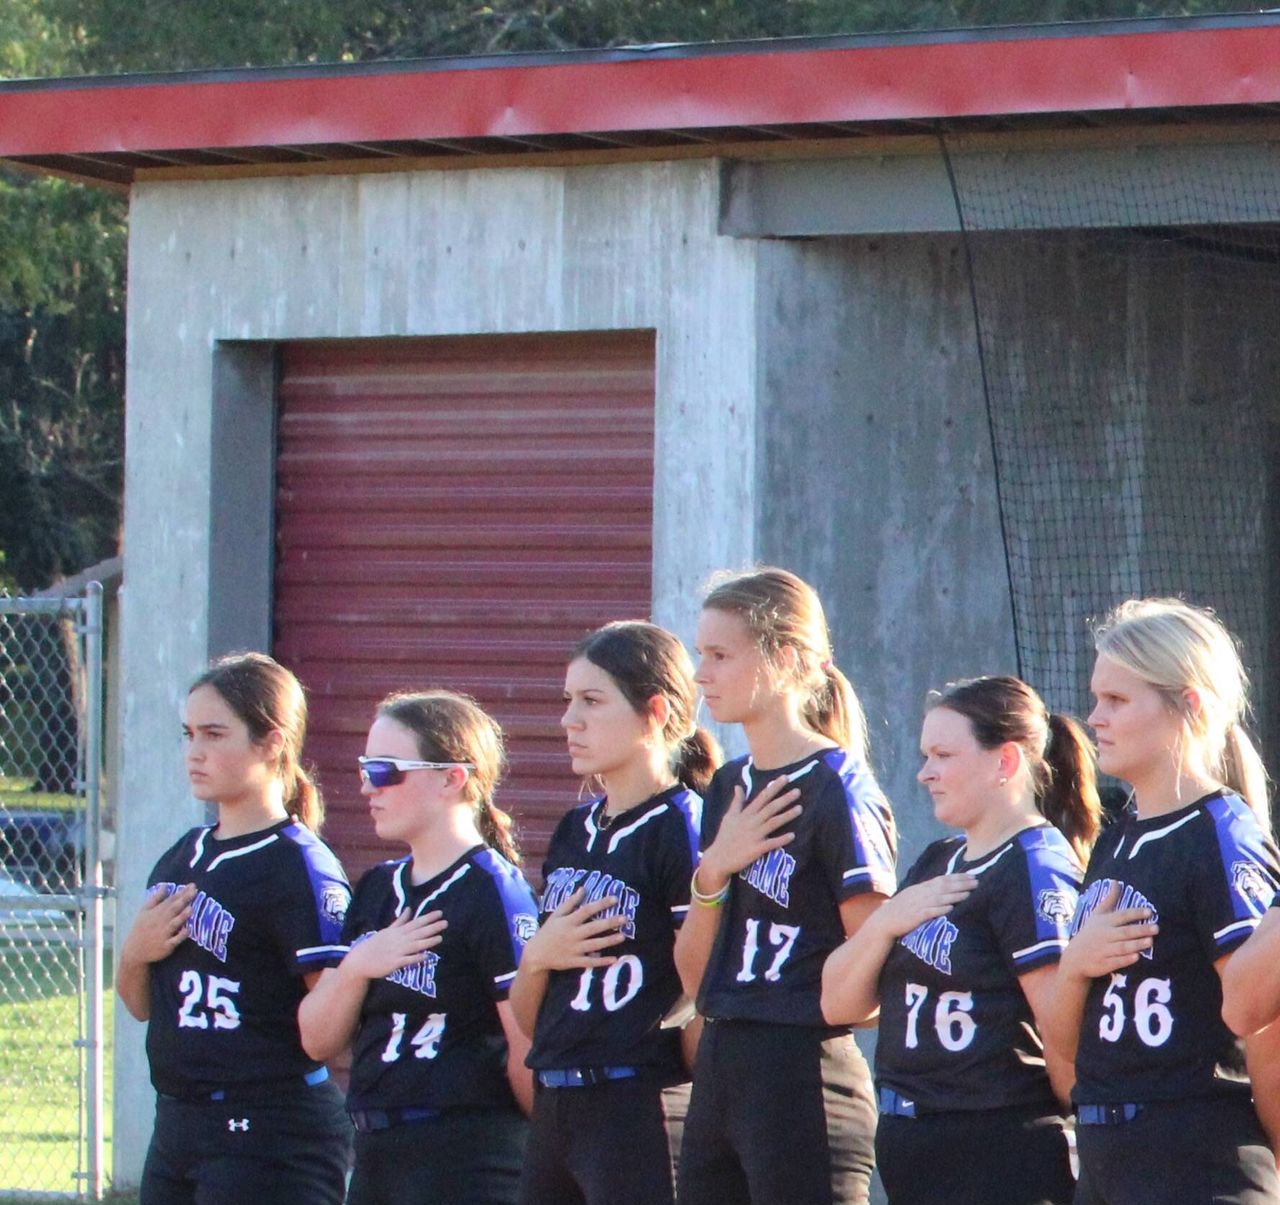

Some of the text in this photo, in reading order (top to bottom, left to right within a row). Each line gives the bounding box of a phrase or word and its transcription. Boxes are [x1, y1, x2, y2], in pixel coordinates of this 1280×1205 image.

[739, 848, 796, 909] AME
[186, 890, 235, 963] AME
[736, 918, 800, 982] 17
[178, 970, 241, 1029] 25
[570, 955, 643, 1012] 10
[1099, 972, 1174, 1047] 56
[381, 1012, 447, 1062] 14
[905, 981, 977, 1052] 76
